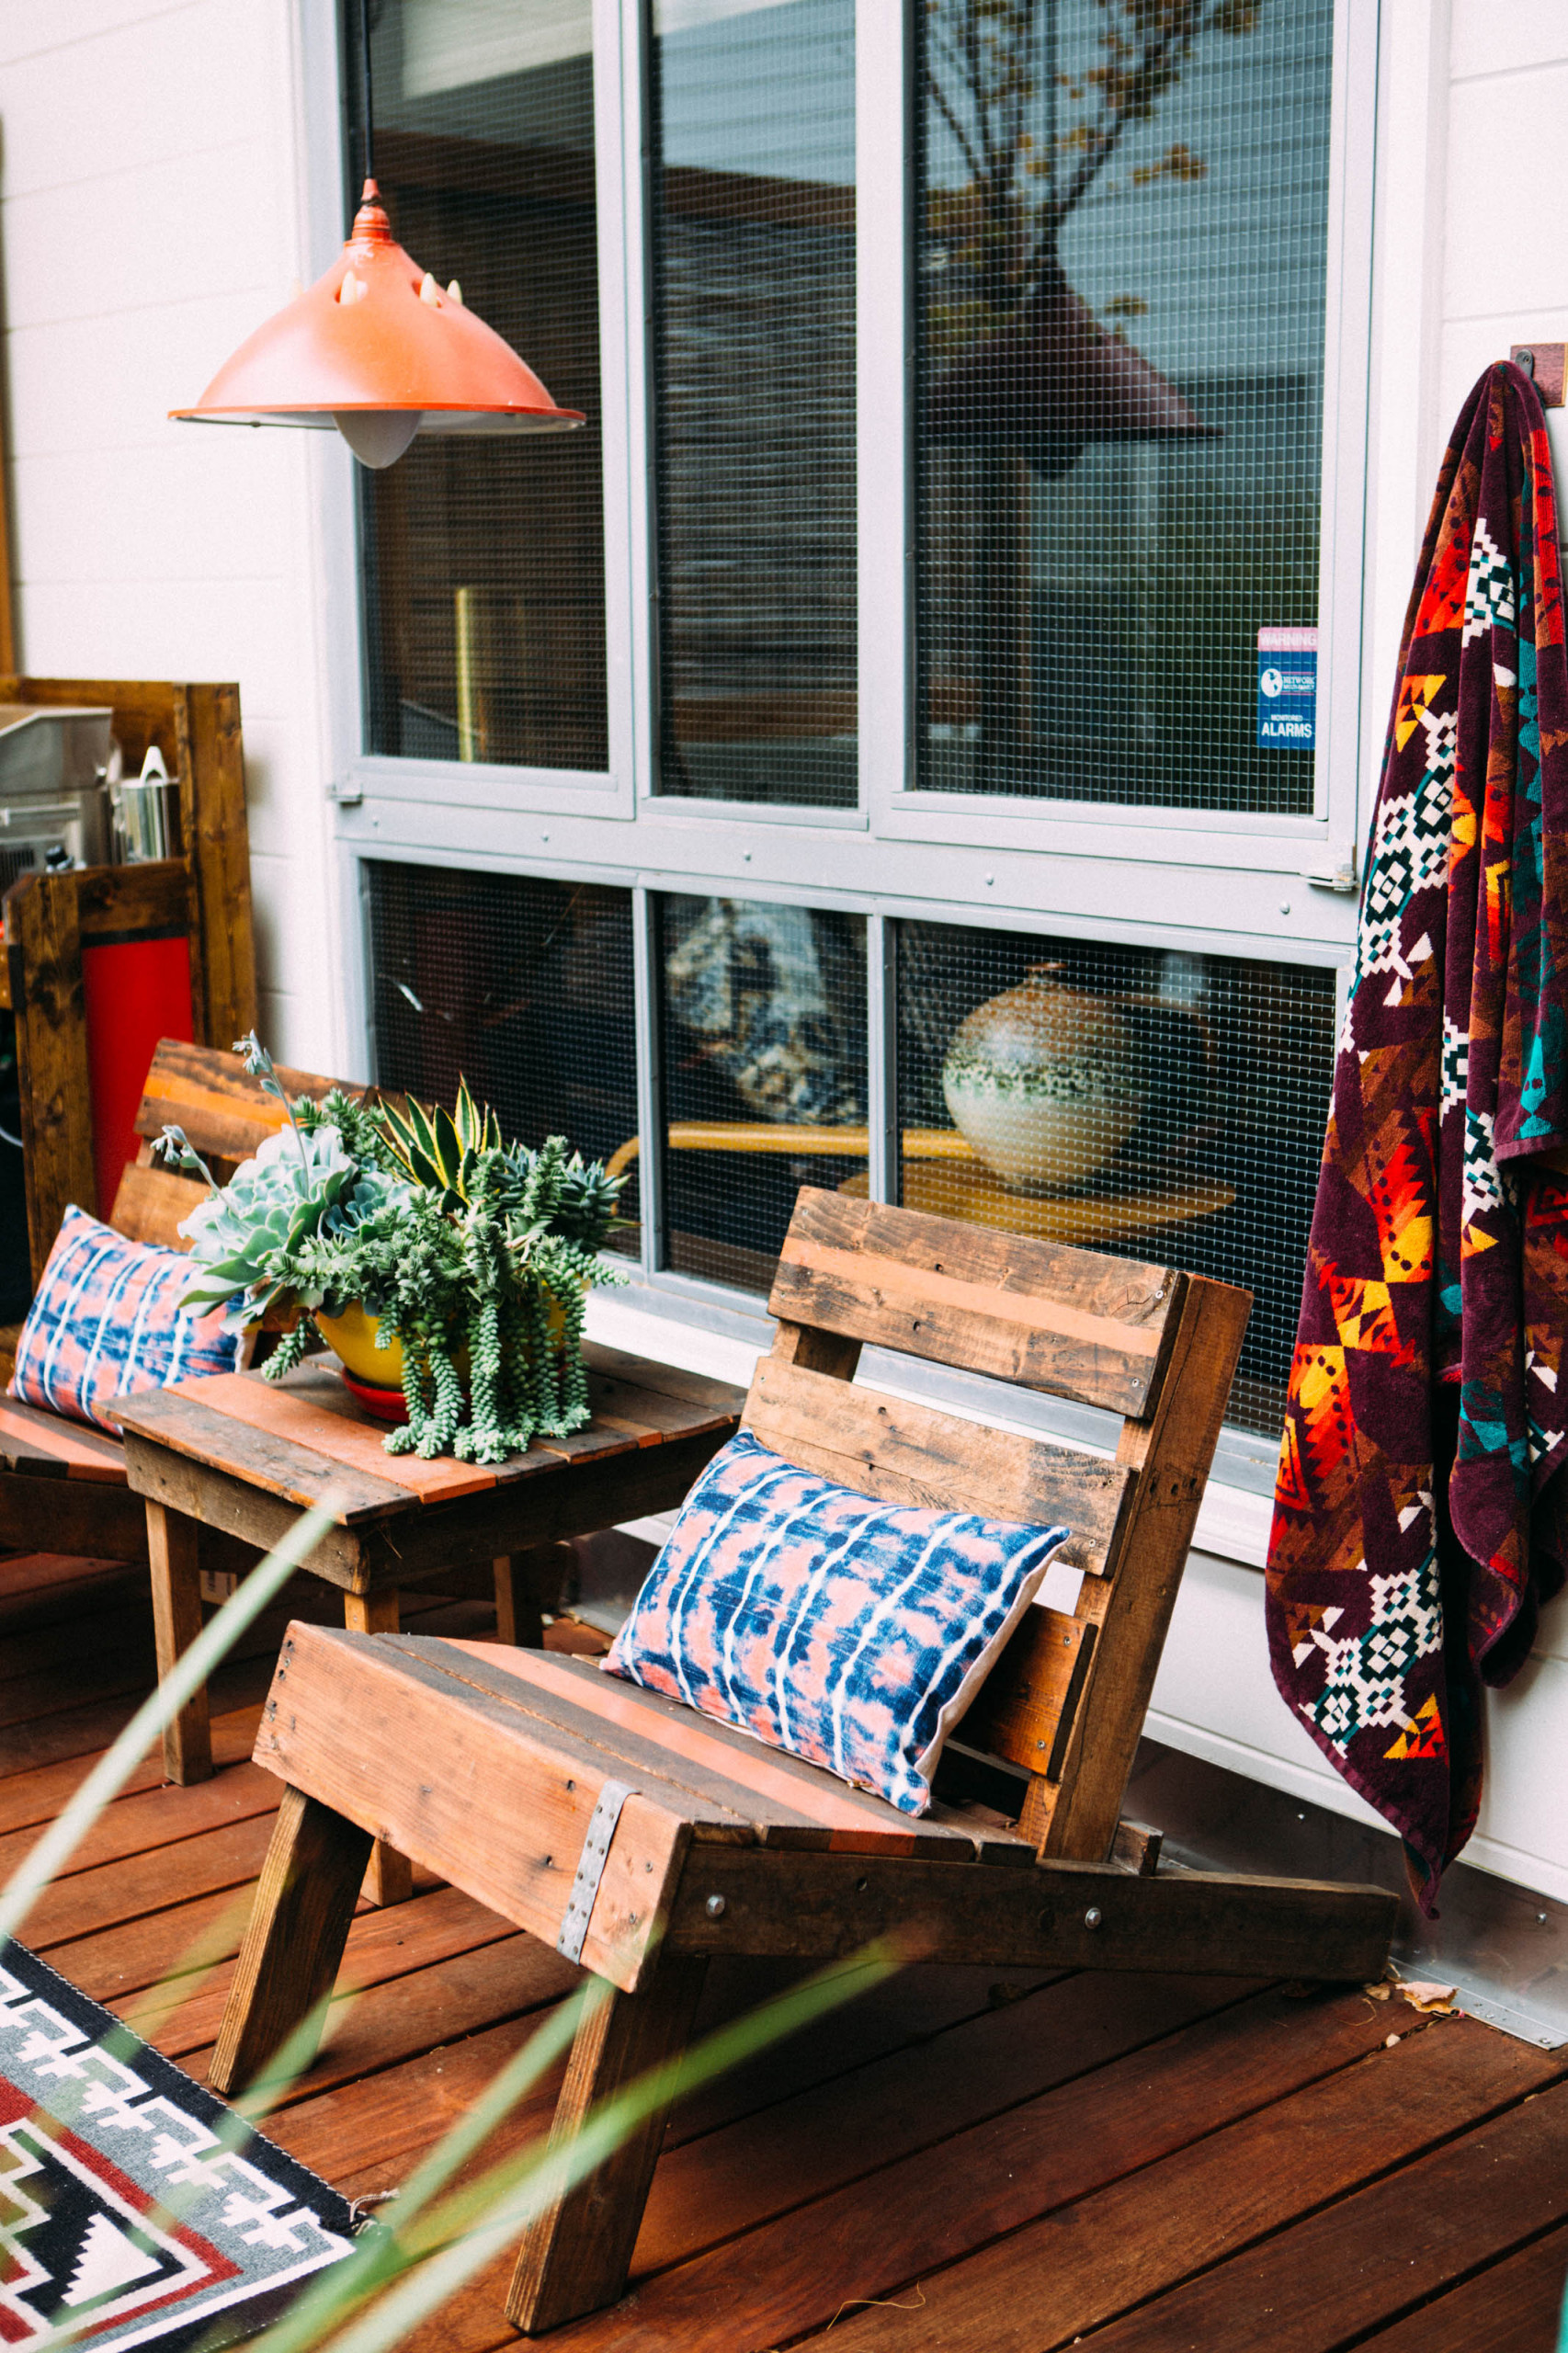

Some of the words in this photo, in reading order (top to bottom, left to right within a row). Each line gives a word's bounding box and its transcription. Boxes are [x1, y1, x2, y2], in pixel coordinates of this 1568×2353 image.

[1260, 632, 1316, 647] WARNING
[1283, 676, 1314, 684] NETWORK
[1261, 722, 1312, 738] ALARMS
